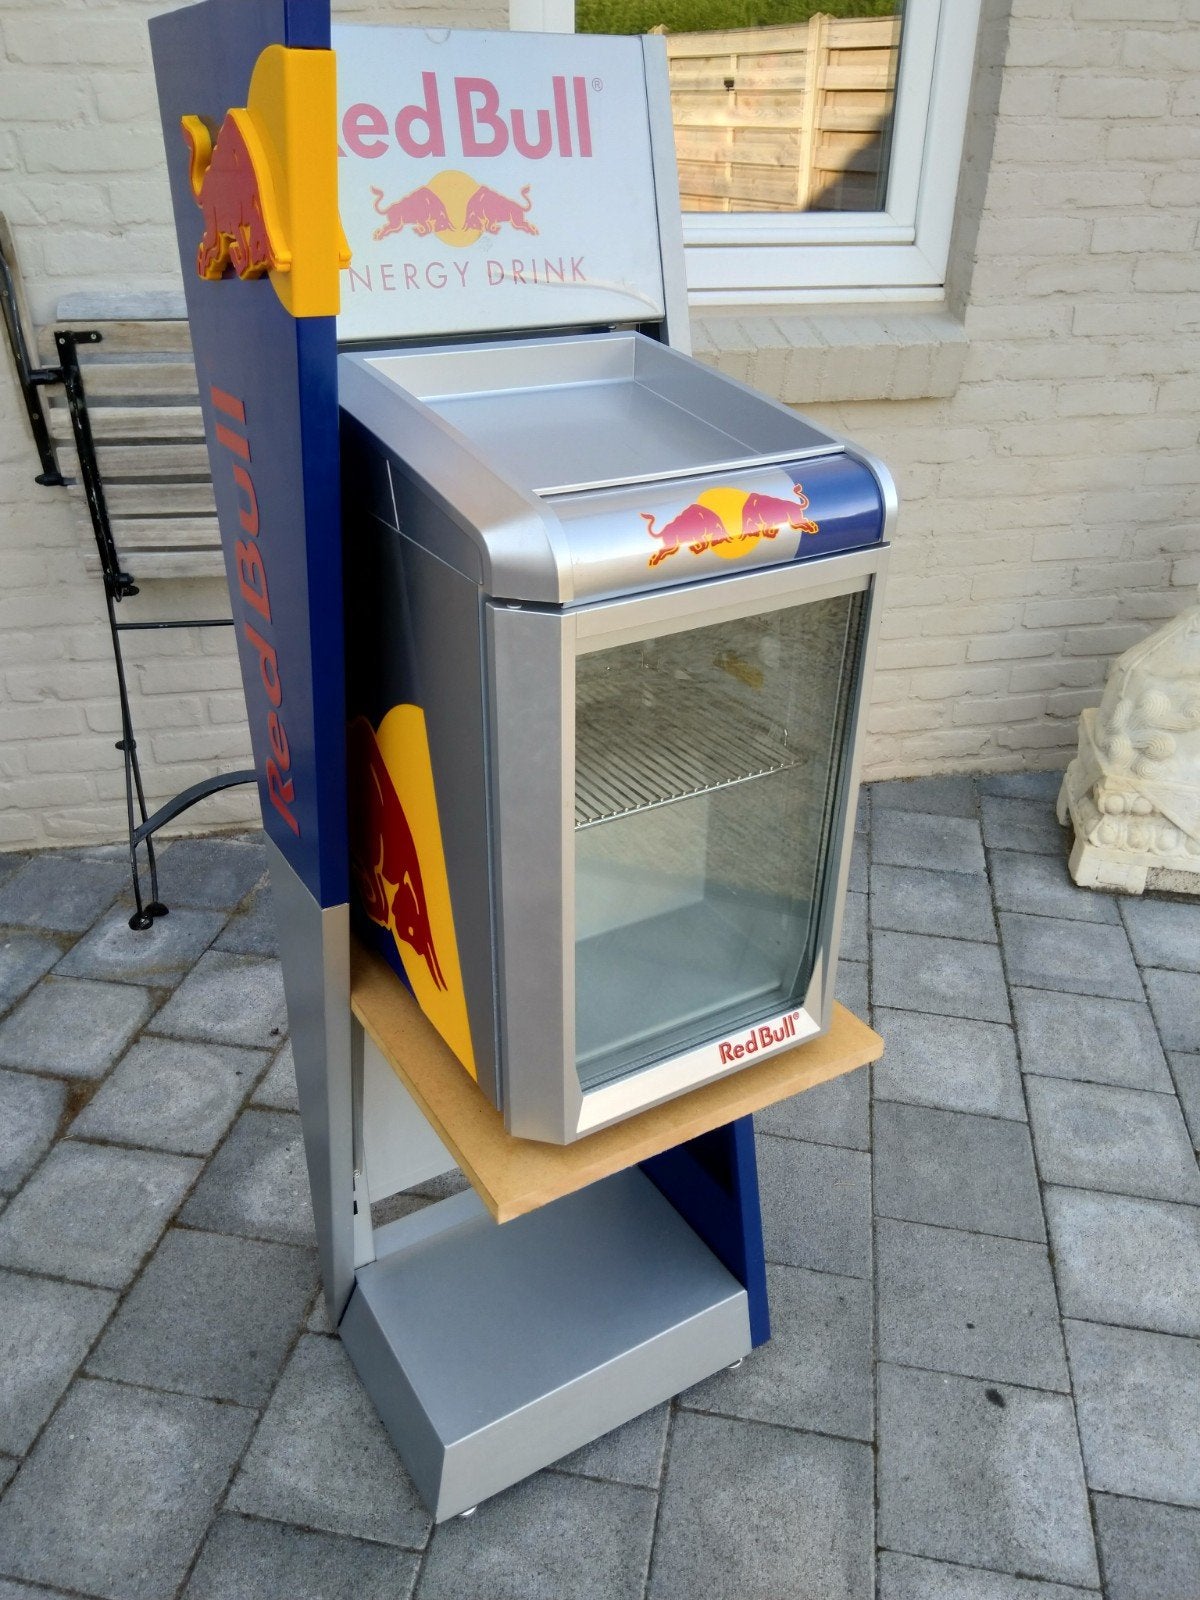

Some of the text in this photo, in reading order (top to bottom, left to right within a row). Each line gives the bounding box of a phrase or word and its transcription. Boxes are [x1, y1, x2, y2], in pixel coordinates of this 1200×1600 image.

[337, 71, 593, 160] ed Bull
[348, 256, 587, 292] NERGY DRINK
[210, 385, 300, 837] Red Bull
[719, 1014, 796, 1065] Red Bull
